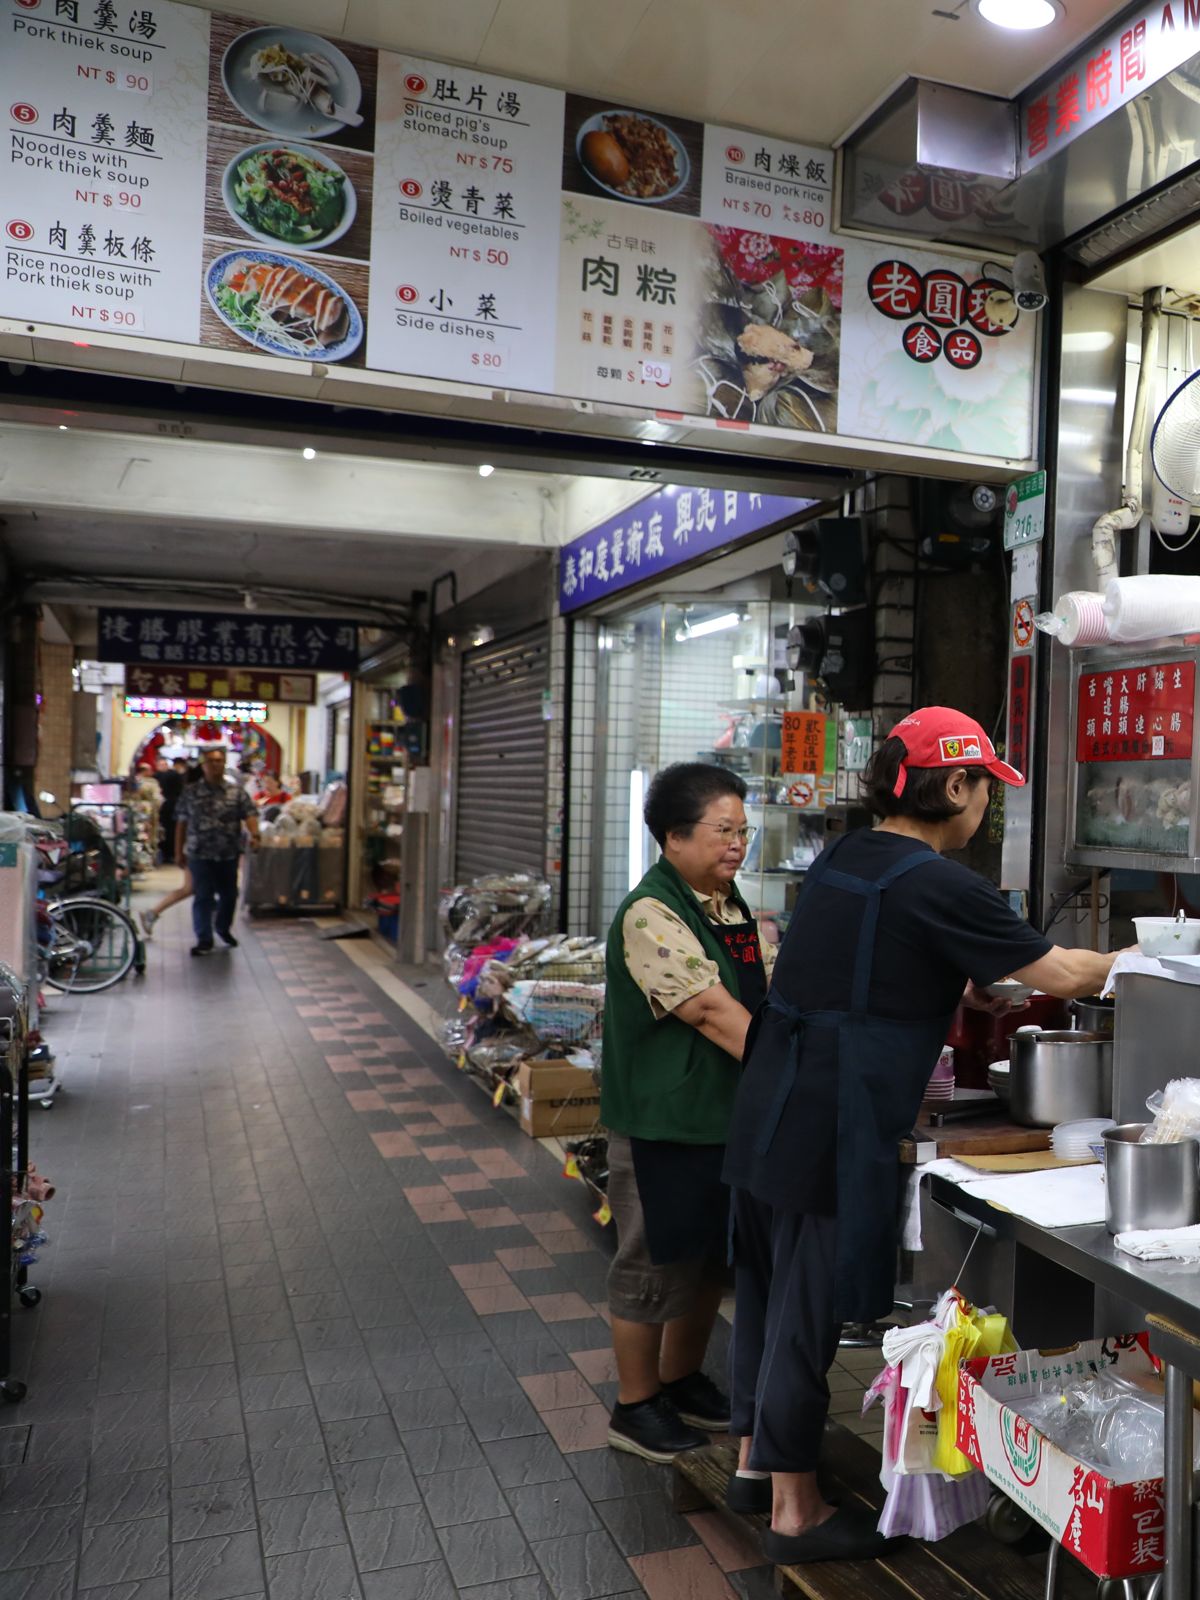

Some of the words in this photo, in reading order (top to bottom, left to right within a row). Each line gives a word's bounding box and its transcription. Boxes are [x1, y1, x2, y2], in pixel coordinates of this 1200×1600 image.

[14, 20, 56, 41] Pork
[62, 30, 105, 52] thiek
[110, 43, 153, 63] soup
[432, 79, 521, 118] 肚片湯
[1027, 19, 1147, 158] 營業時間
[53, 107, 156, 153] 肉羹麵
[403, 103, 451, 124] Sliced
[456, 116, 490, 132] pig's
[403, 118, 468, 141] stomach
[472, 133, 508, 150] soup
[11, 151, 53, 170] Pork
[59, 161, 101, 179] thiek
[107, 171, 150, 189] soup
[12, 135, 87, 161] Noodles
[92, 151, 128, 168] with
[754, 147, 827, 184] 肉燥飯
[430, 180, 516, 220] 燙青菜
[725, 172, 772, 191] Braised
[774, 184, 800, 197] pork
[802, 188, 824, 203] rice
[49, 220, 156, 264] 肉羹板條
[400, 208, 443, 227] Boiled
[447, 218, 519, 241] vegetables
[607, 233, 657, 255] 古早味
[6, 267, 46, 285] Pork
[50, 275, 91, 292] thiek
[95, 284, 135, 300] soup
[7, 252, 45, 270] Rice
[50, 261, 115, 281] noodles
[120, 271, 152, 287] with
[581, 255, 678, 305] 肉粽
[396, 314, 434, 330] Side
[440, 321, 496, 341] dishes
[906, 326, 976, 363] 食品
